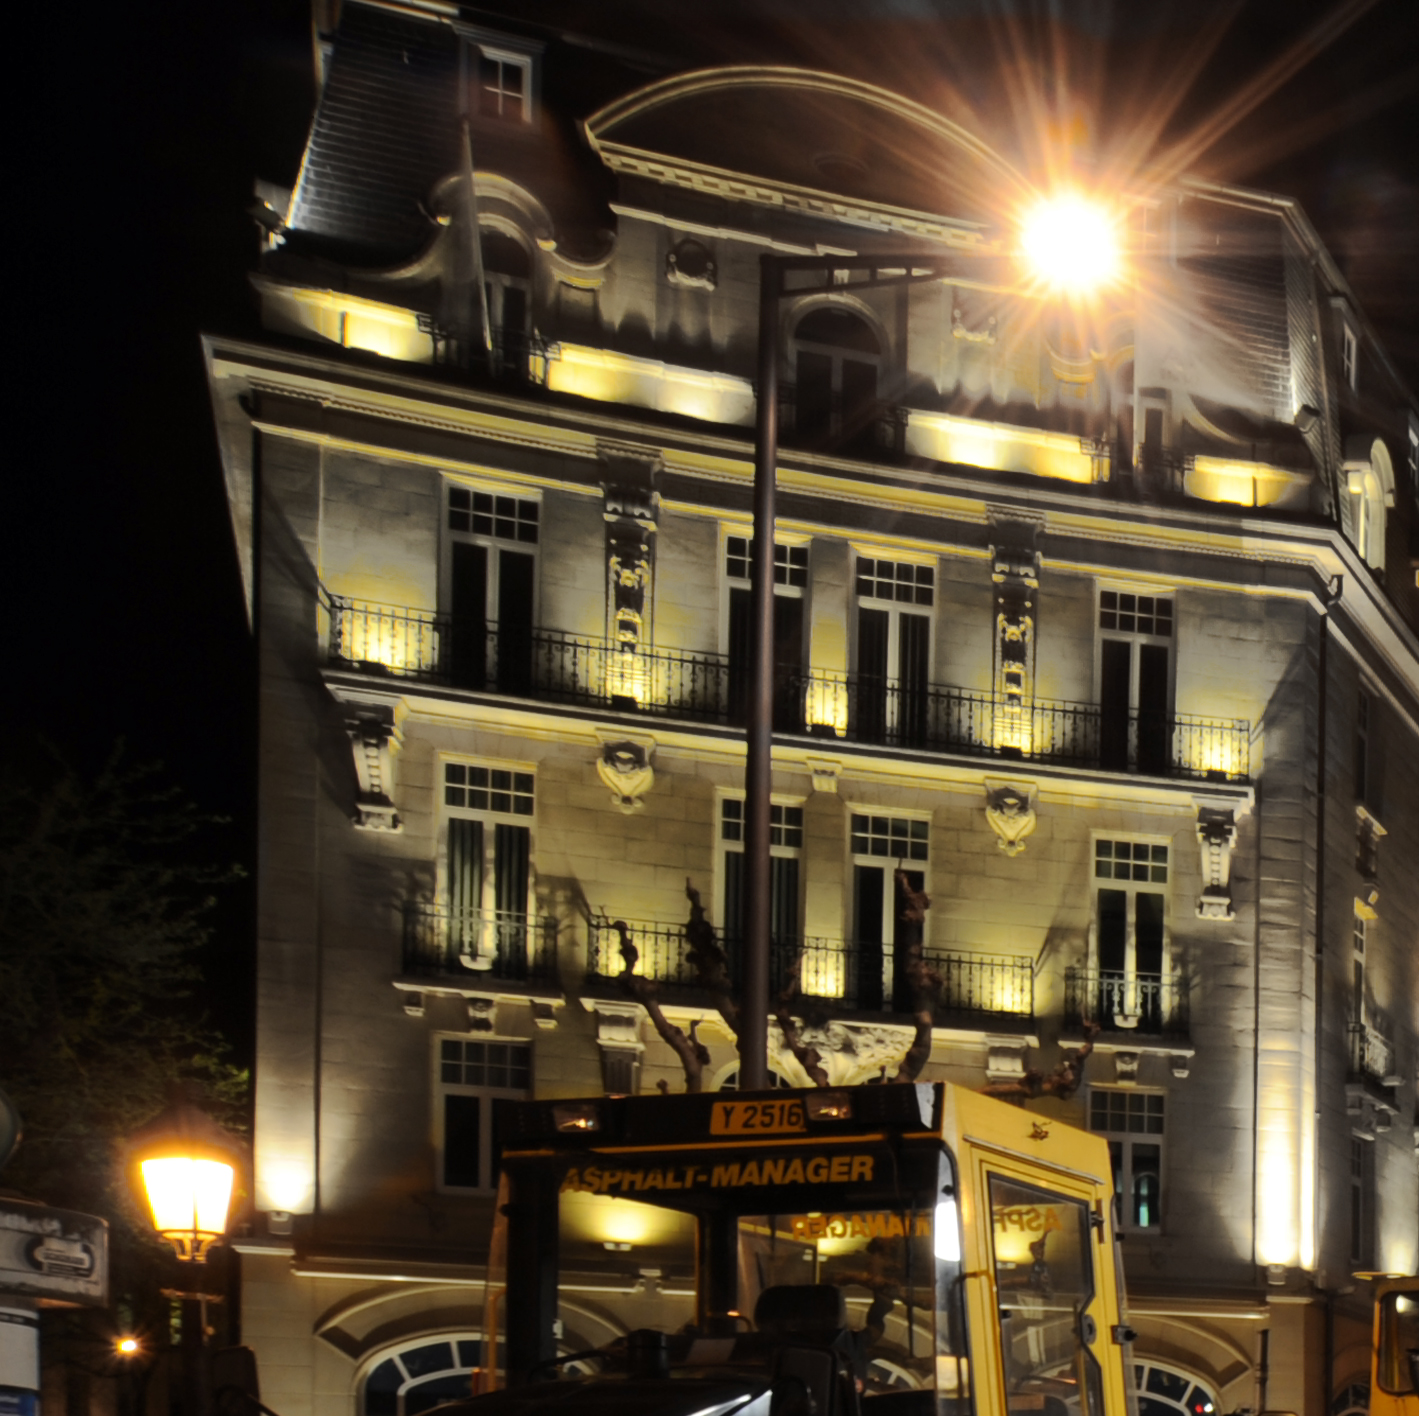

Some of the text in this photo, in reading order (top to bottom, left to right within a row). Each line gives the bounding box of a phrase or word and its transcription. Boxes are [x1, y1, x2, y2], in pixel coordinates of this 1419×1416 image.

[722, 1102, 802, 1128] Y 2516
[558, 1154, 875, 1193] ASPHALT-MANAGER
